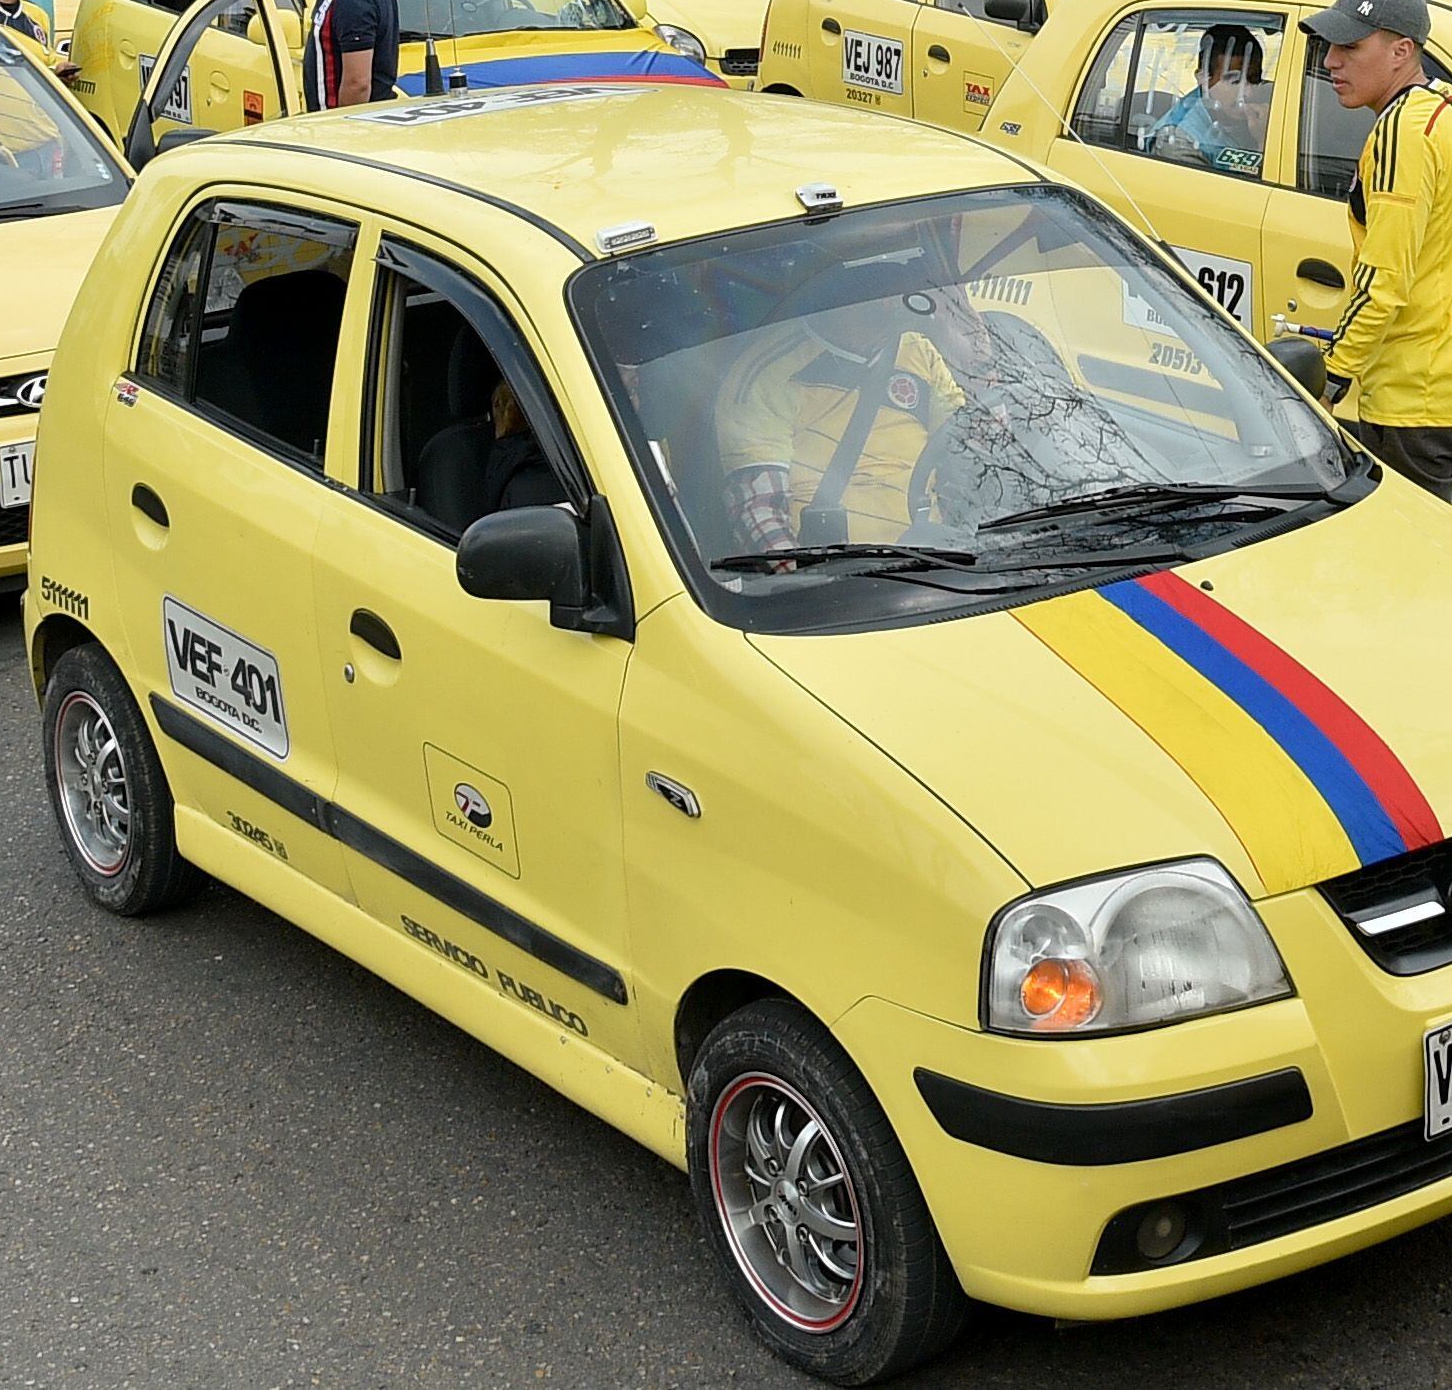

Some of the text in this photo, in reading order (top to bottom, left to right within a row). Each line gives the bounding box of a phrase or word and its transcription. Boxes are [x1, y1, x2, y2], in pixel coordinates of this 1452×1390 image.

[844, 36, 902, 82] VEJ 987
[849, 72, 880, 88] BOGOTA
[845, 88, 874, 105] 20327
[966, 82, 991, 97] TAX
[1198, 266, 1245, 322] 612
[167, 617, 282, 726] VEF 401
[195, 686, 241, 722] BOGOTA
[445, 810, 505, 853] TAXI PERLA
[400, 913, 589, 1038] SERVICIO PUBLICO
